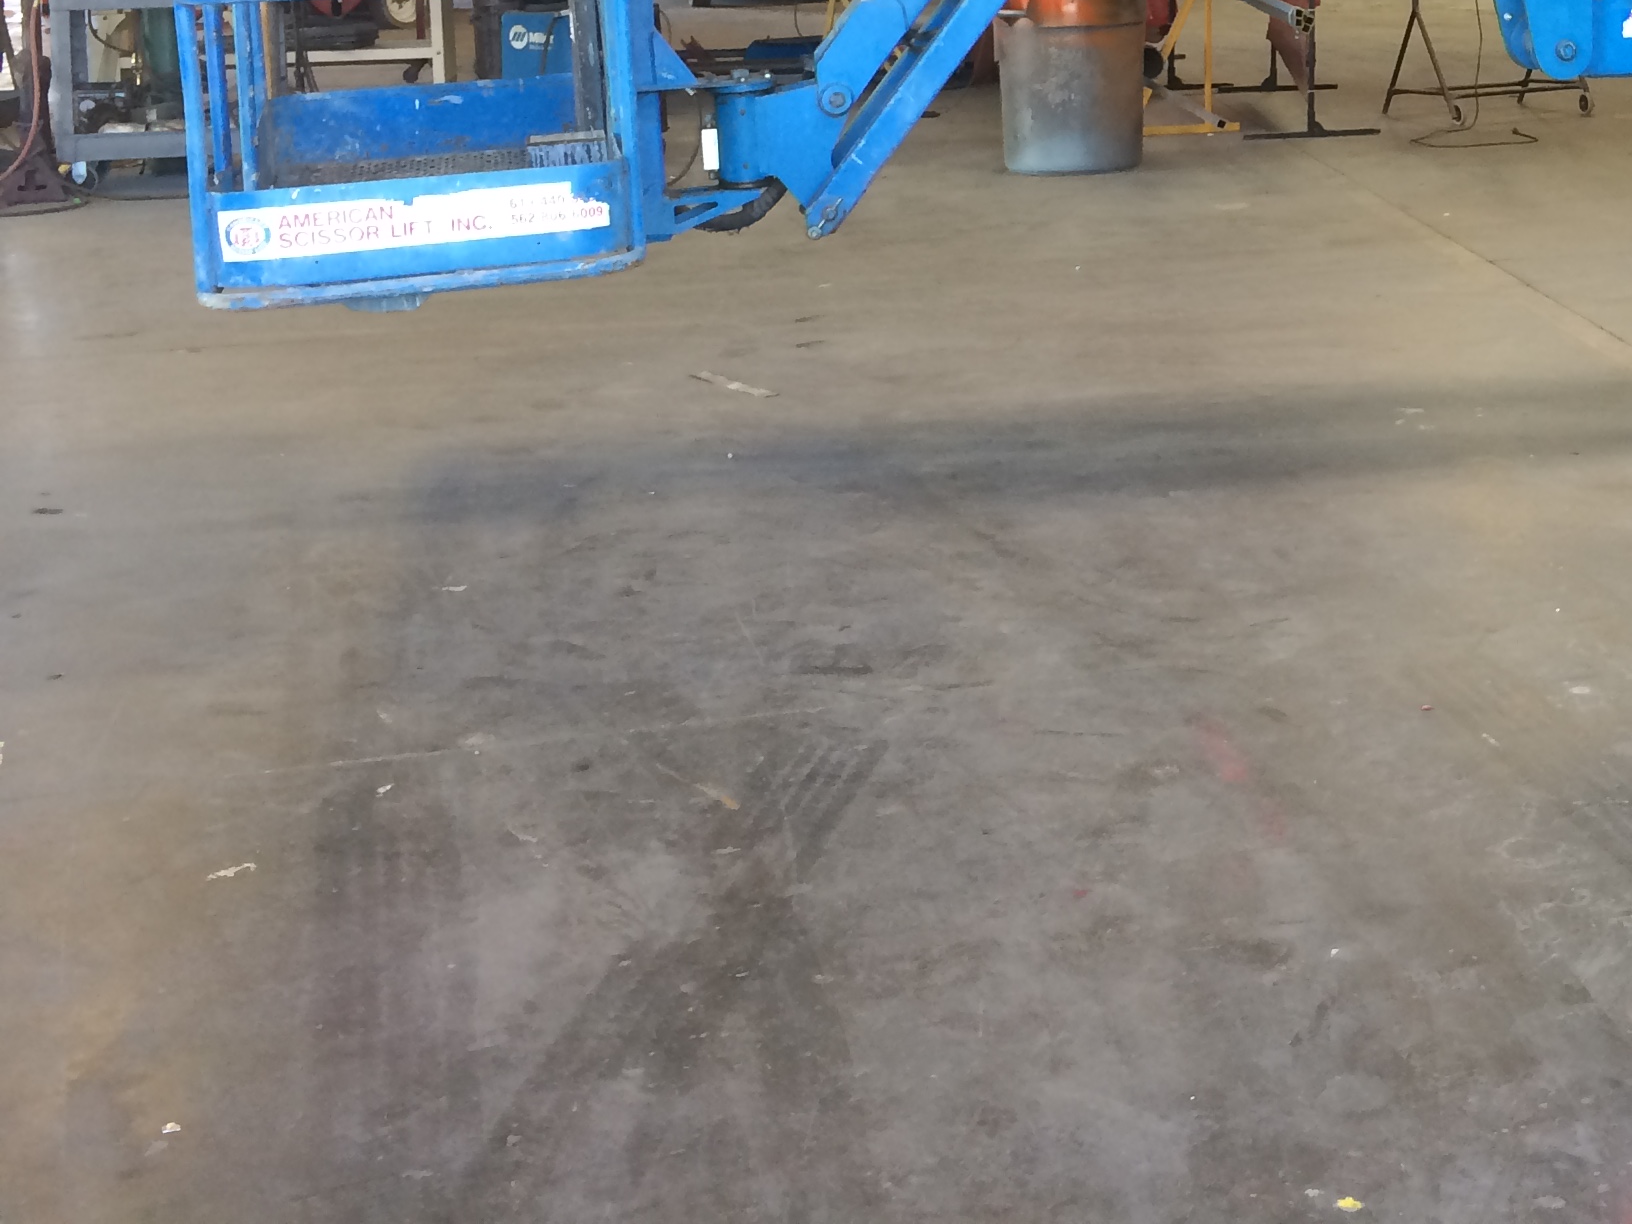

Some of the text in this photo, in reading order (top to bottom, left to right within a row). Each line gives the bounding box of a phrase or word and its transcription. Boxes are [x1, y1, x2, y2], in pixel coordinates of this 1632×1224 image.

[279, 206, 393, 230] AMERICAN
[279, 226, 379, 249] SCISSOR
[391, 220, 432, 239] LIFT
